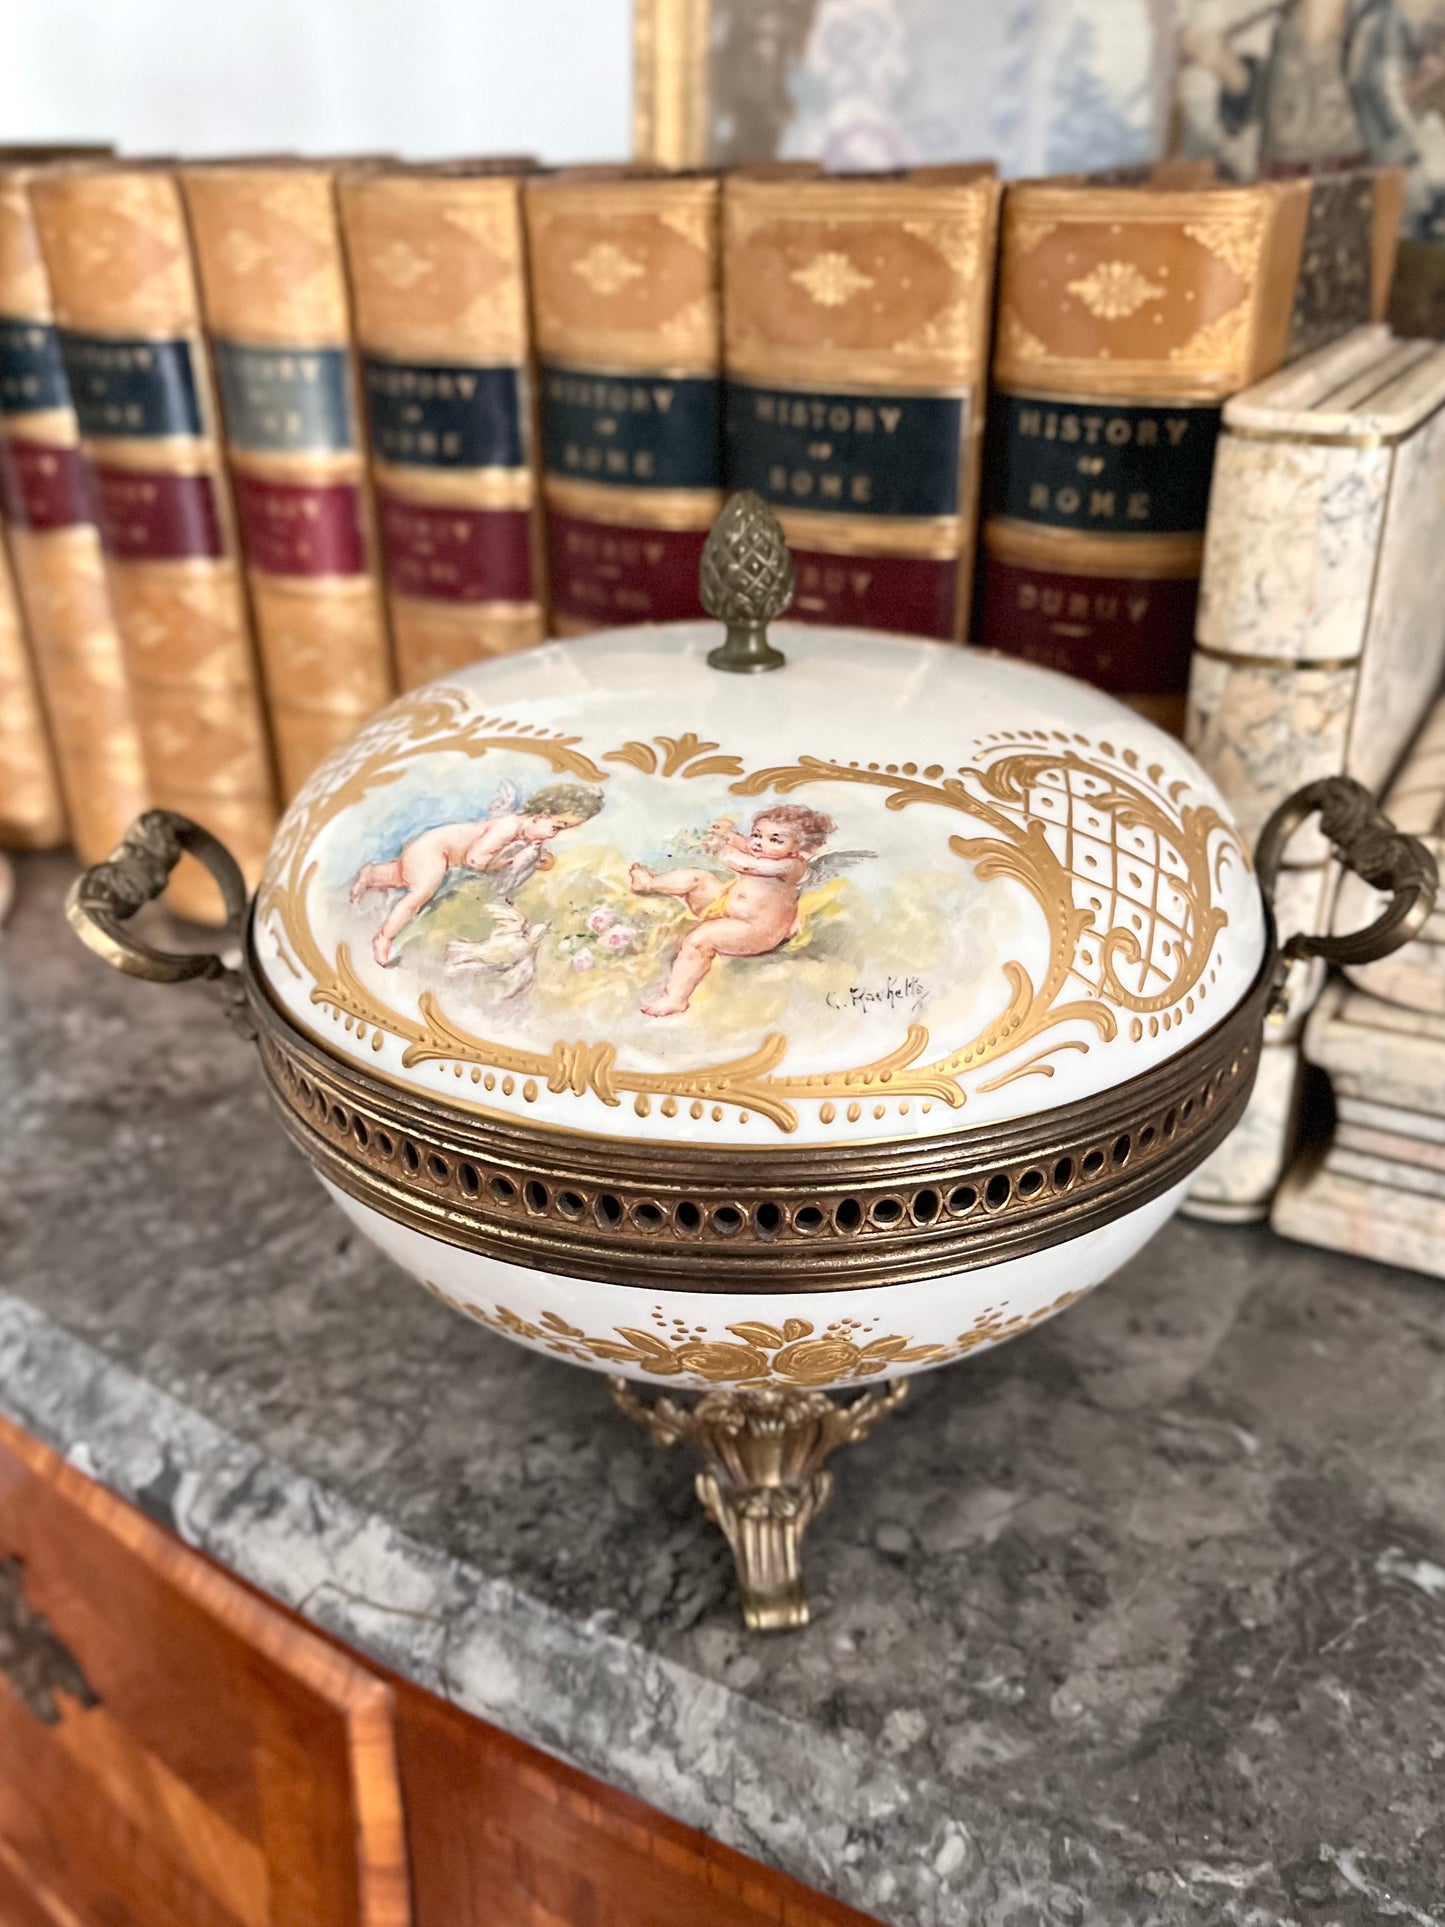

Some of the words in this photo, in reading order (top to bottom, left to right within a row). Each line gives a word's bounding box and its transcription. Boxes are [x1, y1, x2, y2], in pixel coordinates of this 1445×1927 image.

[754, 395, 903, 434] HISTORY
[1017, 409, 1189, 446] HISTORY
[768, 464, 871, 503] ROME
[1077, 455, 1105, 476] OF
[1029, 483, 1150, 520] ROME
